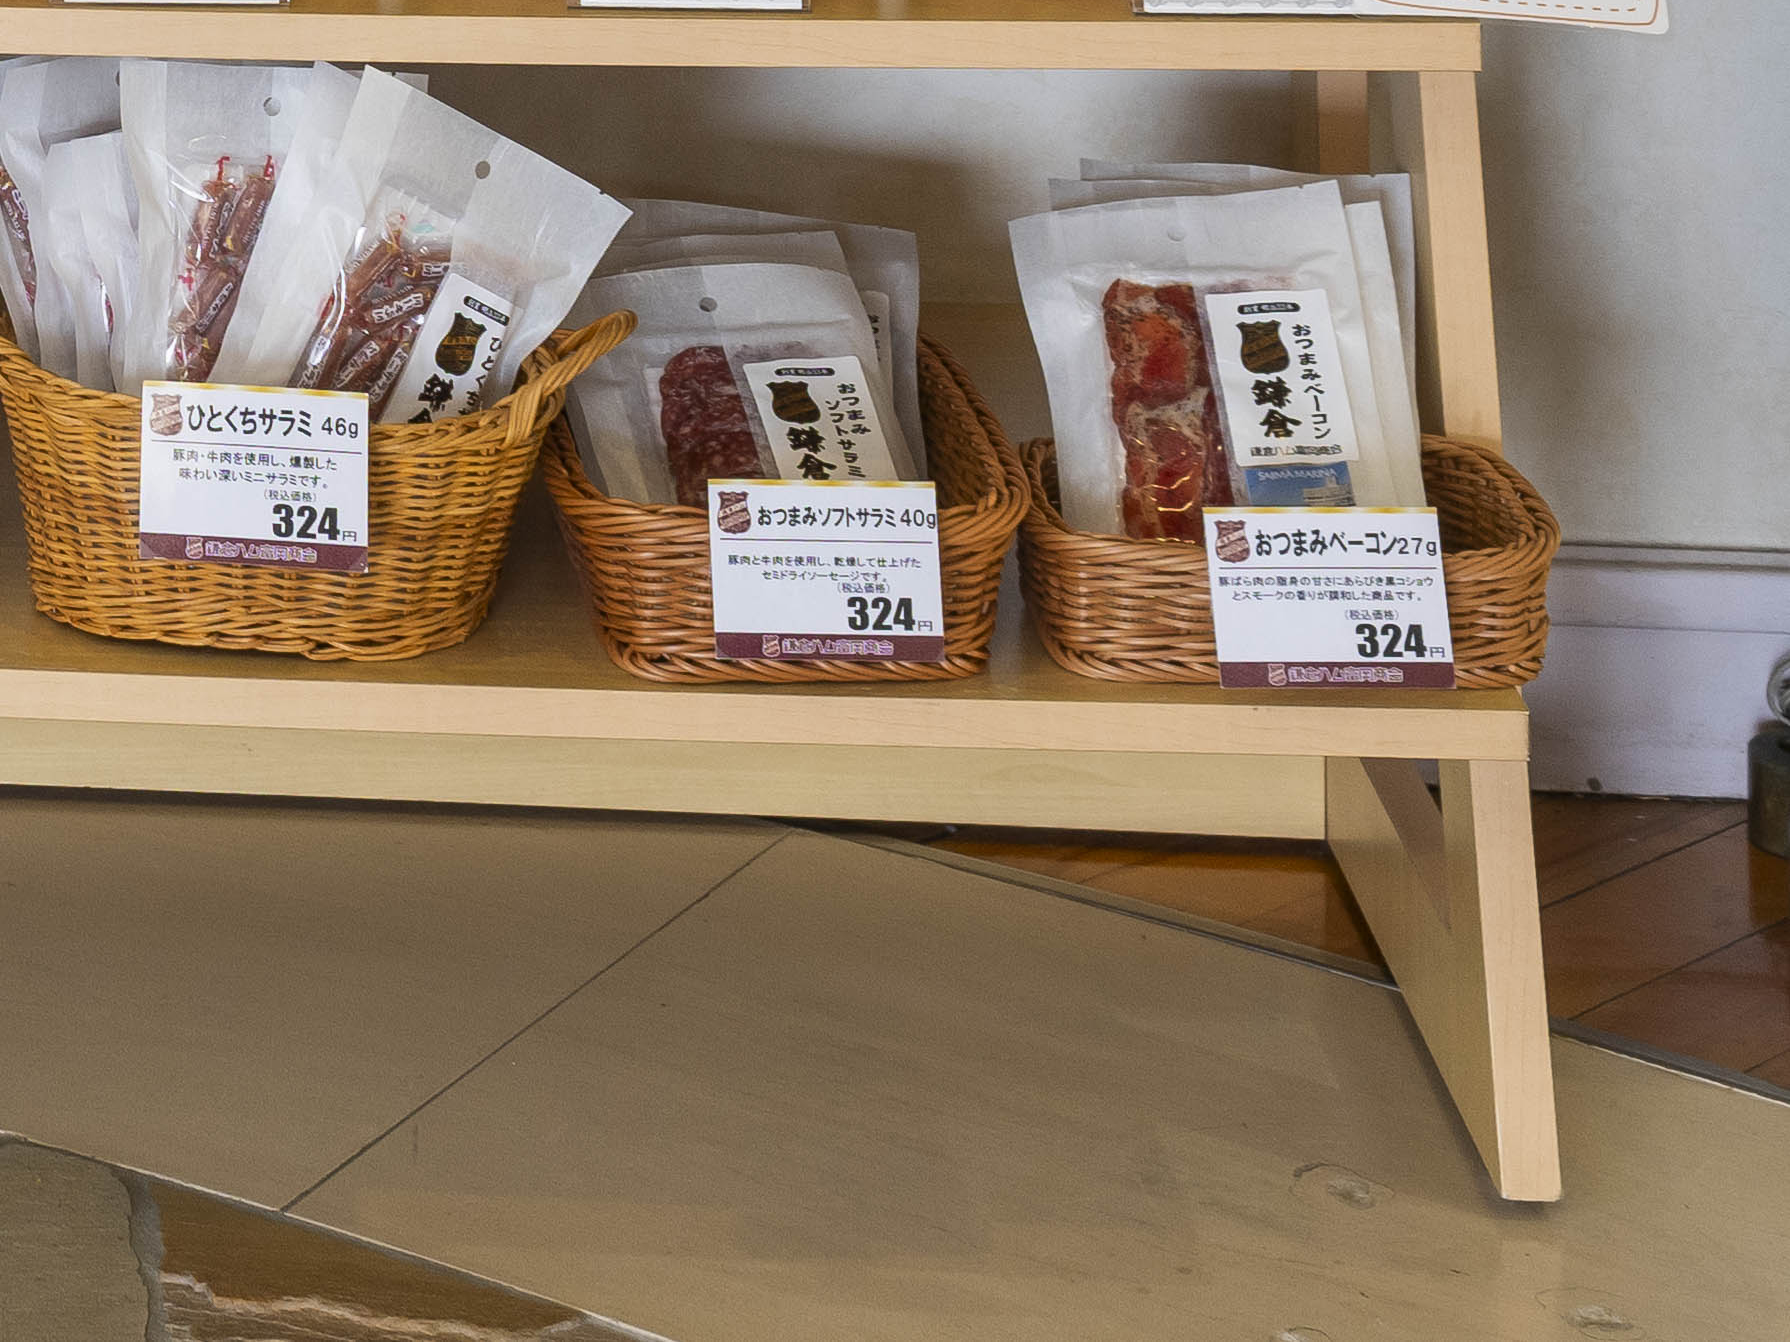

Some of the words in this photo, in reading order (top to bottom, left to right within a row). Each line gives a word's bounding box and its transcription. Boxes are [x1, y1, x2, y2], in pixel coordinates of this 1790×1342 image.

[1252, 376, 1302, 439] 鎌倉
[1292, 322, 1331, 441] おつまみベーコン
[186, 403, 312, 438] ひとくちサラミ
[321, 417, 359, 439] 46g
